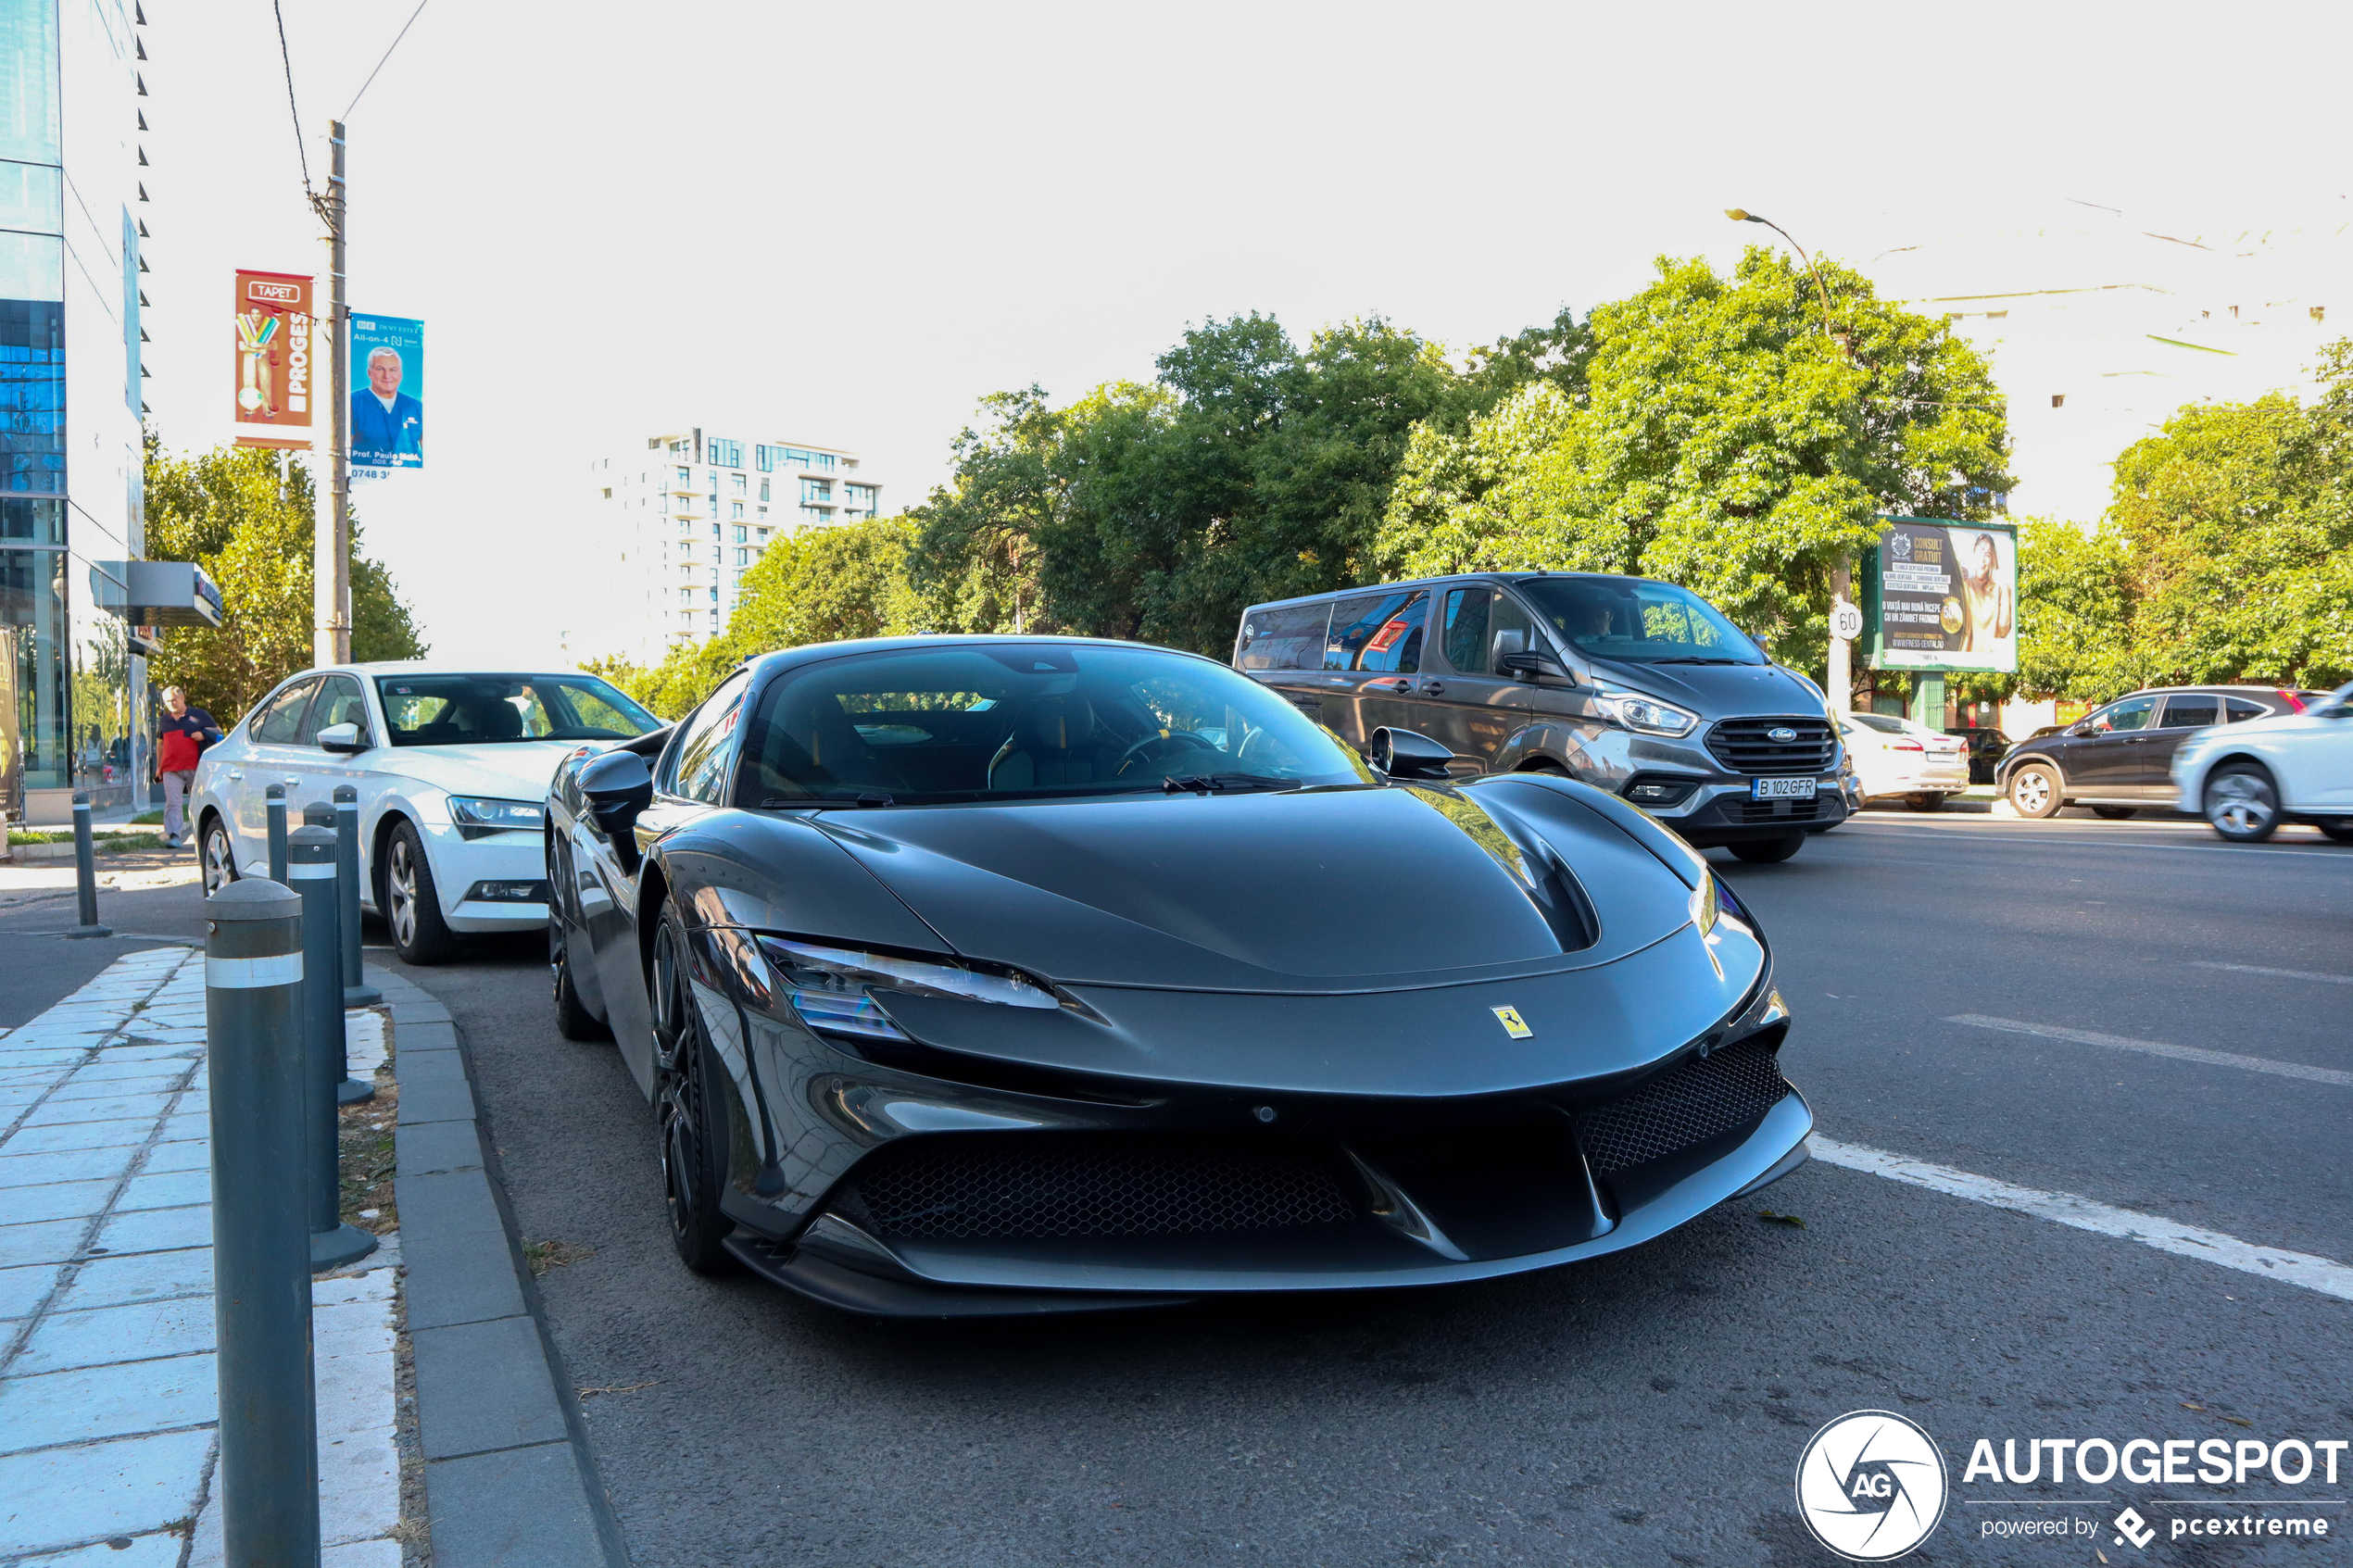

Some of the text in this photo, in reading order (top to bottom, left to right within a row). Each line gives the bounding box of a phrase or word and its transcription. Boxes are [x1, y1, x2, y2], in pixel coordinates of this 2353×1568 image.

[258, 285, 291, 299] TAPET
[353, 333, 388, 344] All-on-4
[289, 312, 308, 394] PROGES
[352, 450, 371, 458] Prof.
[374, 451, 398, 460] Paulo
[352, 470, 377, 479] 0748
[1914, 537, 1943, 551] CONSULT
[1914, 550, 1942, 563] GRATUIT
[1882, 601, 1886, 610] O
[1901, 601, 1910, 611] MAI
[1911, 601, 1924, 612] BUNĂ
[1924, 601, 1941, 613] ÎNCEPE
[1839, 612, 1856, 631] 60
[1884, 612, 1891, 621] CU
[1892, 612, 1899, 622] UN
[1899, 611, 1919, 623] ZÂMBET
[1776, 729, 1792, 739] Ford
[1760, 779, 1813, 795] B 102 GFR
[692, 1066, 702, 1179] MICHELIN
